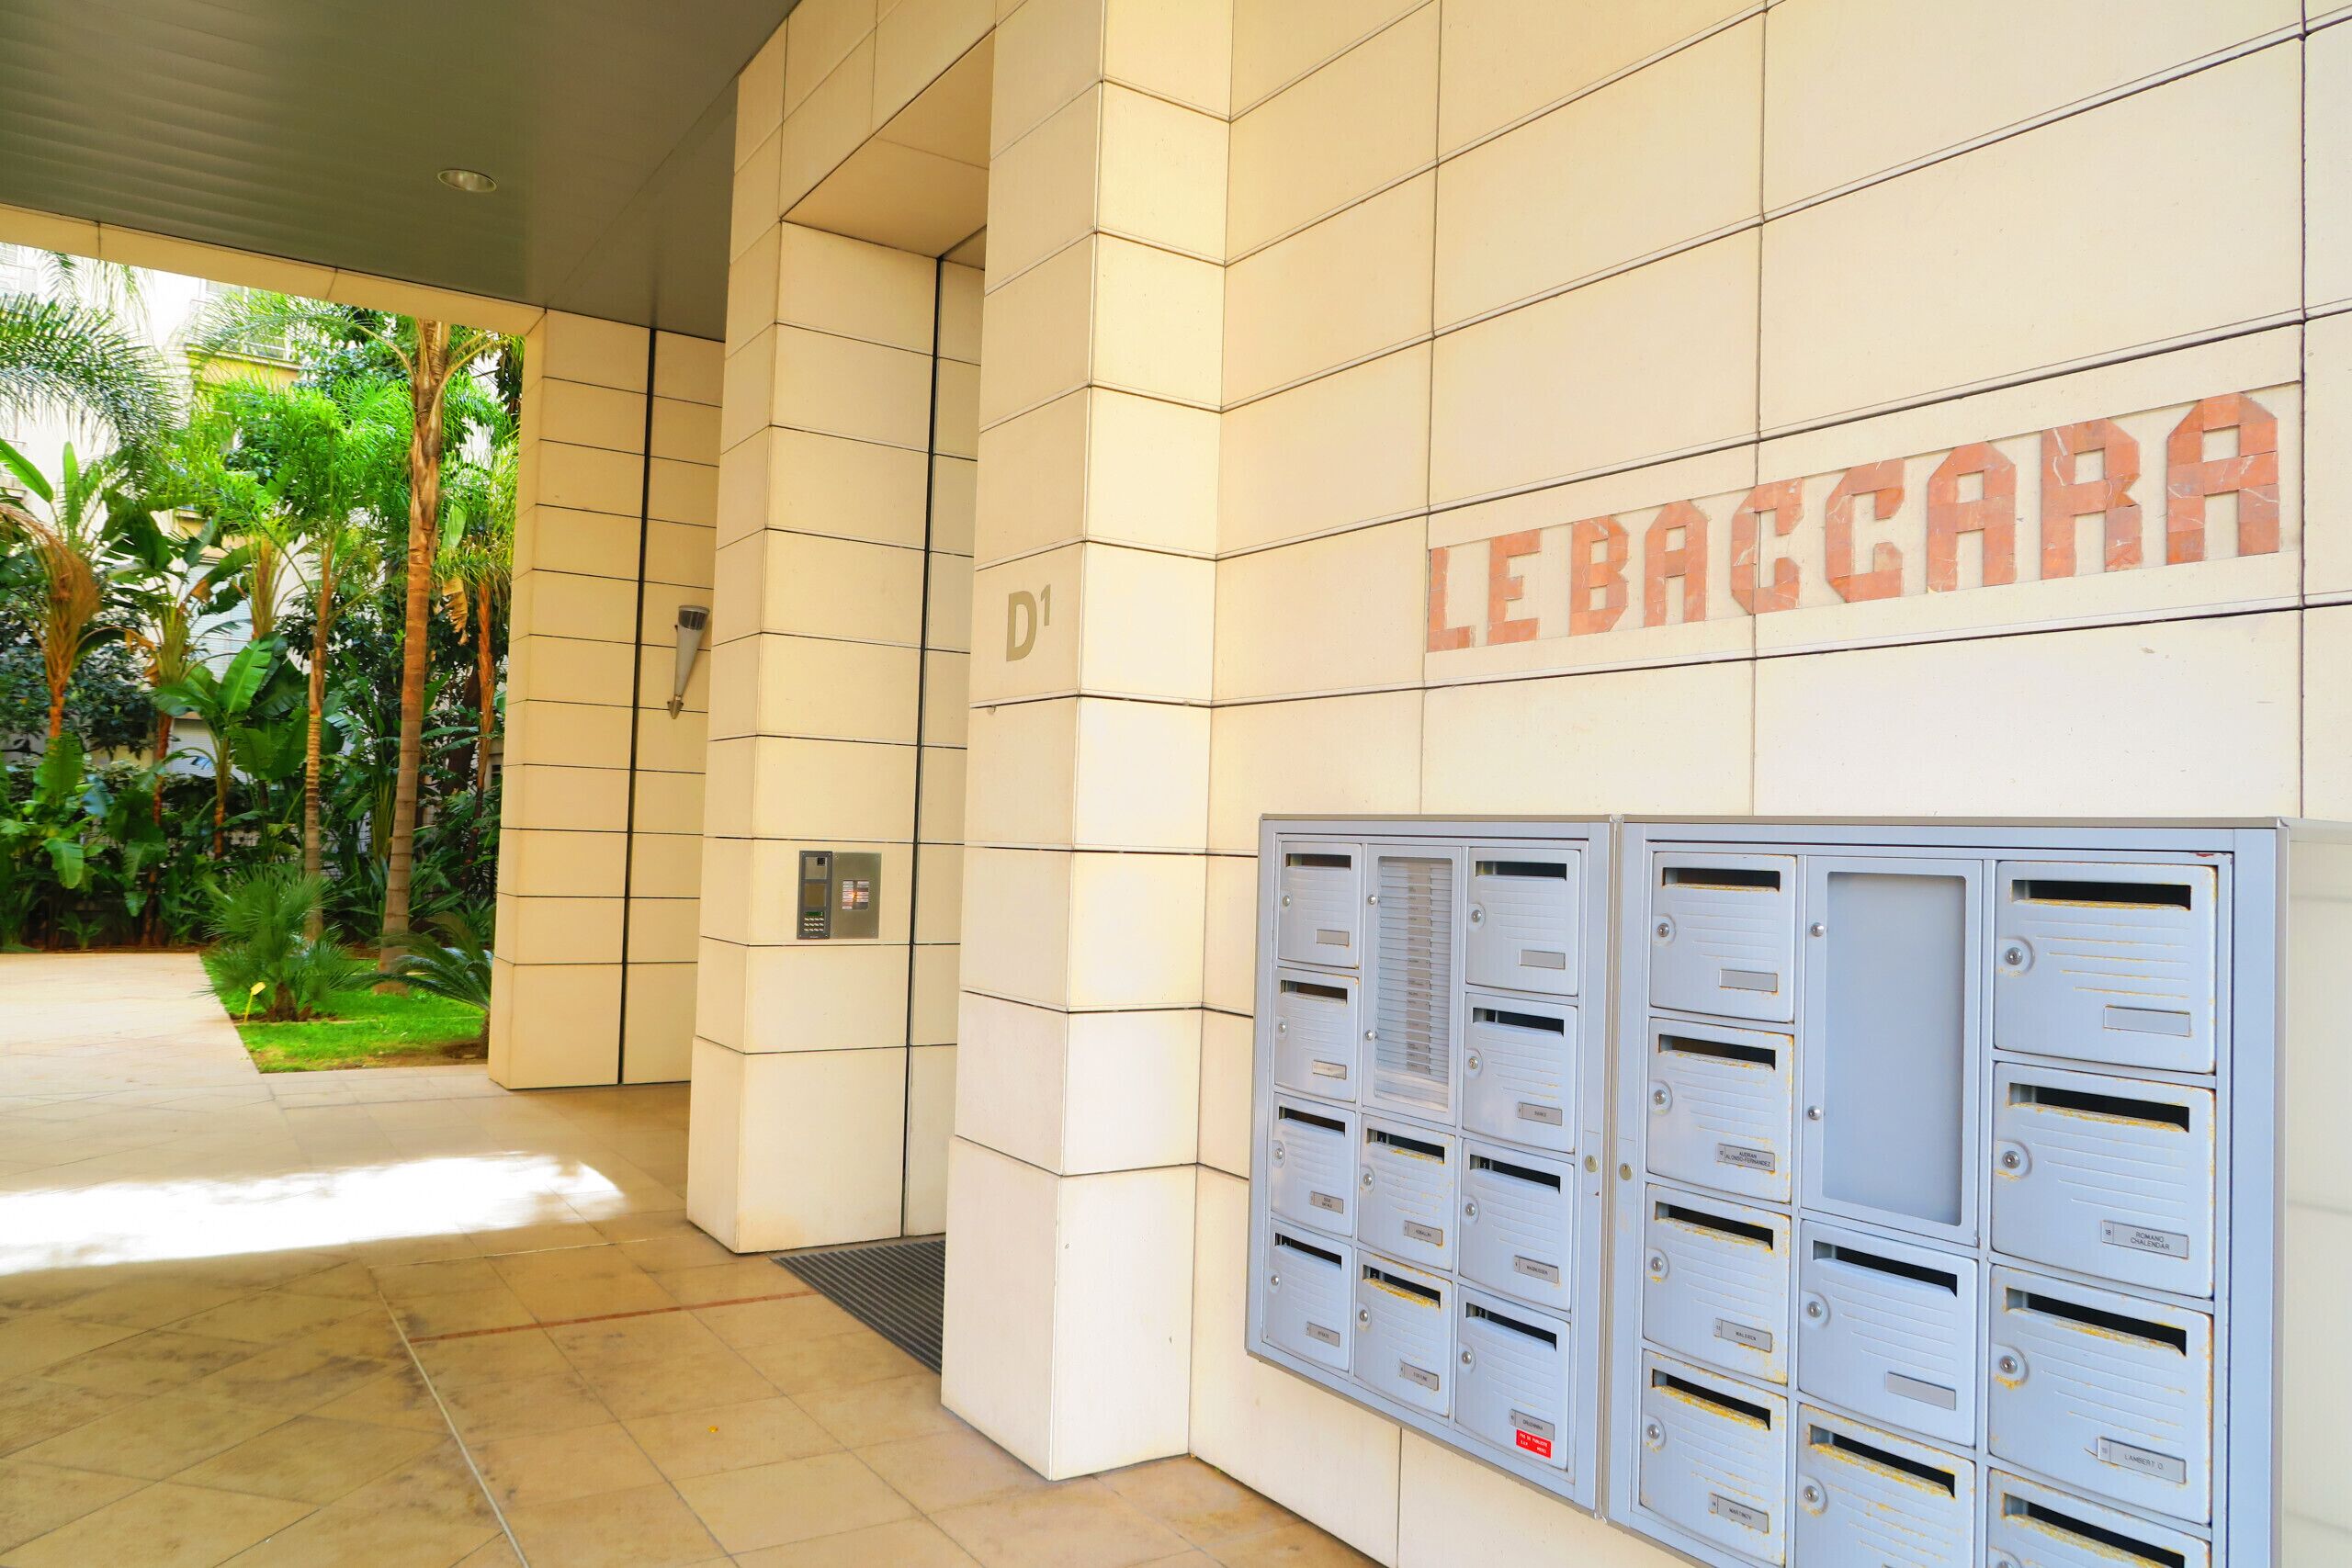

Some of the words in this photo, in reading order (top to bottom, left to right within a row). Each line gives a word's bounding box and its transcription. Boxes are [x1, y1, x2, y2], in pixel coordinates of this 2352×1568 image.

[1427, 528, 1542, 653] LE
[1569, 391, 2280, 637] BACCARA
[2130, 1236, 2170, 1251] CHALENDAR
[2135, 1231, 2165, 1243] ROMANO
[2124, 1453, 2155, 1468] LAMBERT
